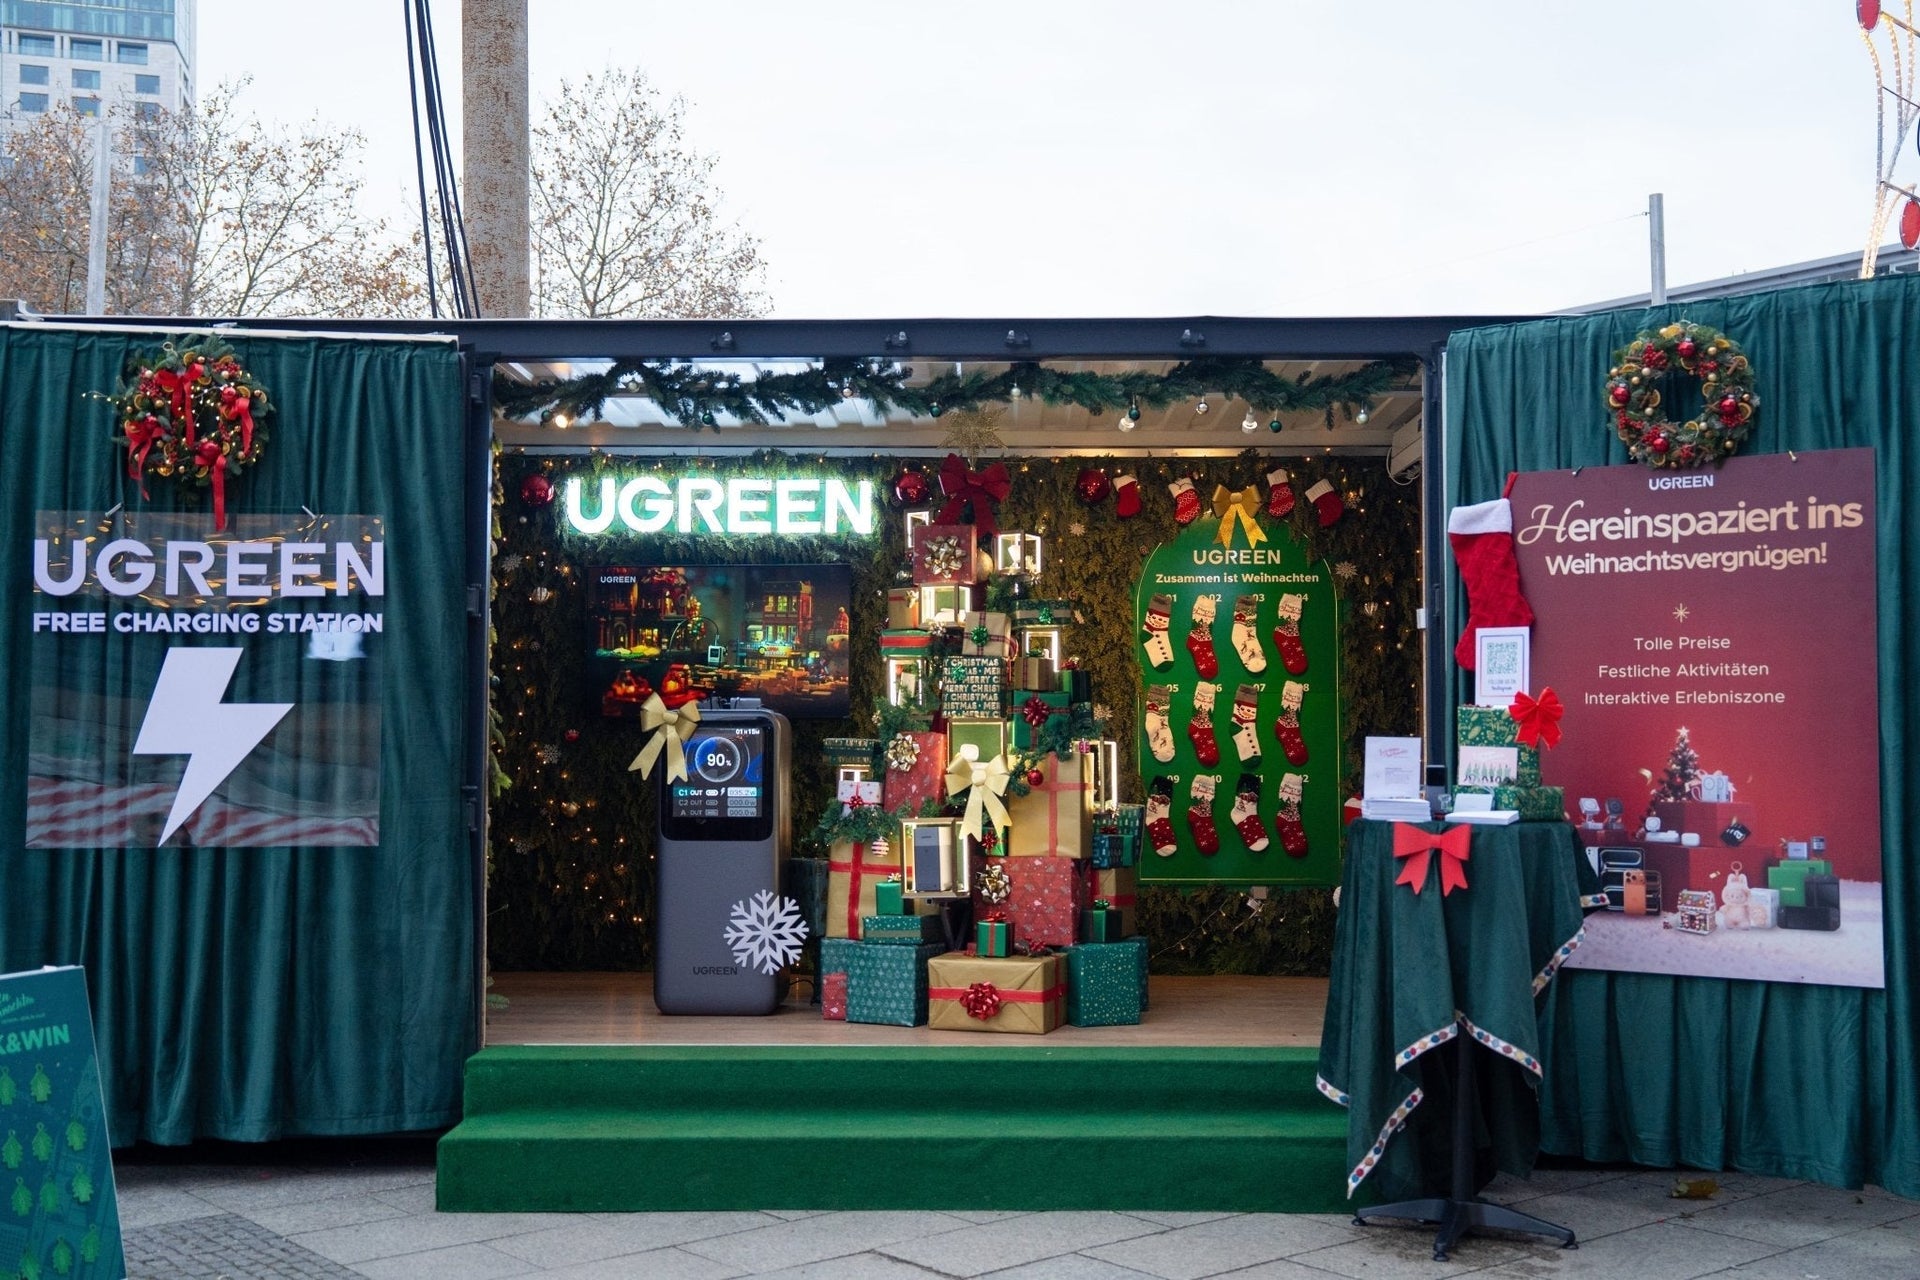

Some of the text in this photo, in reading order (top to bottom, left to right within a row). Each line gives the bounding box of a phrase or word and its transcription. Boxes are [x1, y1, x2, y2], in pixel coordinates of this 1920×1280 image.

[1649, 475, 1714, 491] UGREEN
[566, 477, 873, 534] UGREEN
[1517, 496, 1864, 545] Hereinspaziert ins
[1193, 549, 1281, 565] UGREEN
[1545, 543, 1828, 576] Weihnachtsvergnügen!
[33, 539, 385, 597] UGREEN
[600, 575, 637, 584] UGREEN
[1155, 573, 1319, 583] Zusammen ist Weihnachten
[33, 612, 383, 633] FREE CHARGING STATION
[1633, 636, 1731, 651] Tolle Preise
[1598, 662, 1769, 679] Festliche Aktivitäten
[951, 693, 998, 701] CHRISTMAS
[1585, 690, 1785, 705] Interaktive Erlebniszone
[692, 966, 738, 975] UGREEN
